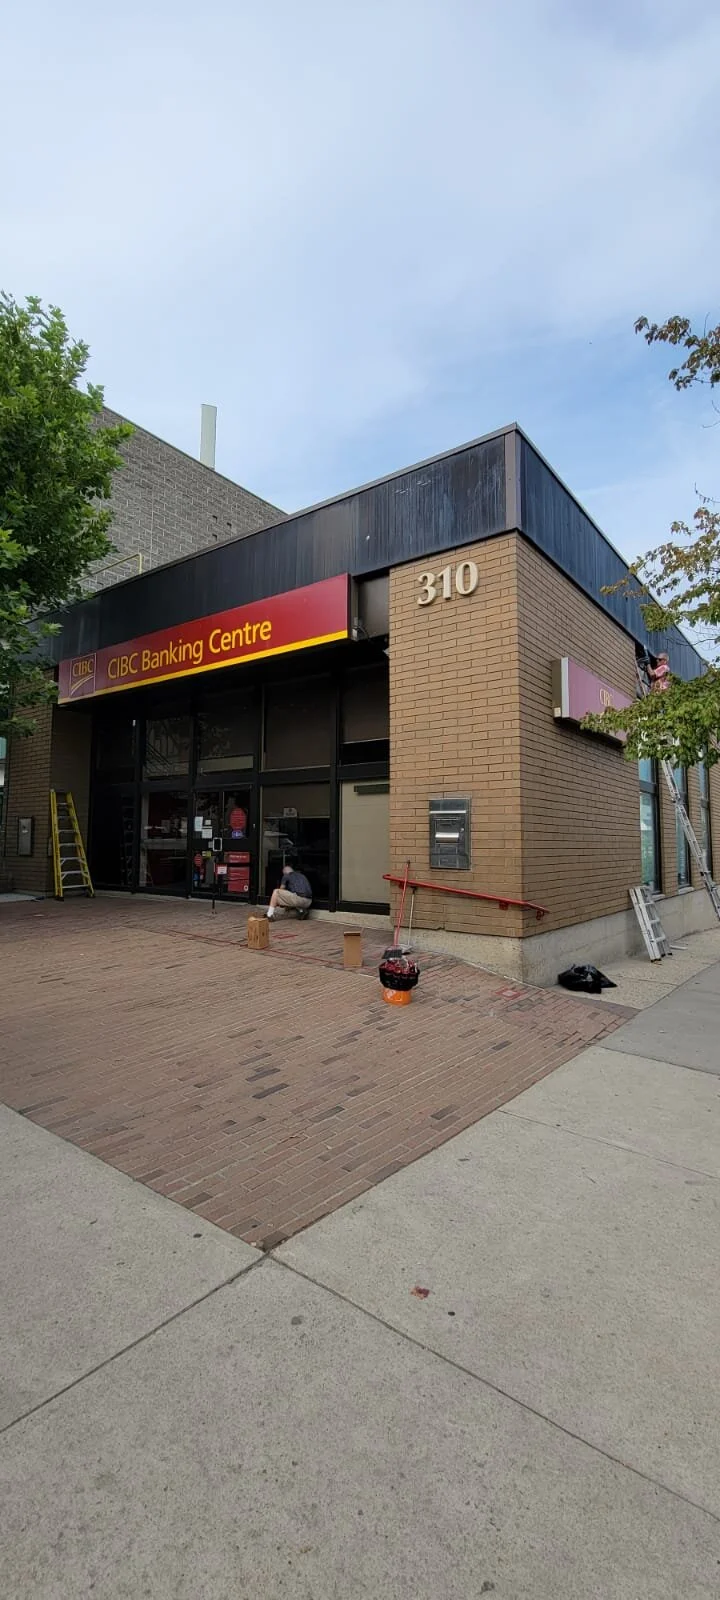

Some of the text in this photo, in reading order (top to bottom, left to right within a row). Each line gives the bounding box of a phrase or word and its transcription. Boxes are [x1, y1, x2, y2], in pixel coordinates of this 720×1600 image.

[417, 561, 478, 605] 310
[72, 658, 94, 677] CIBC
[107, 620, 272, 679] CIBC Banking Centre
